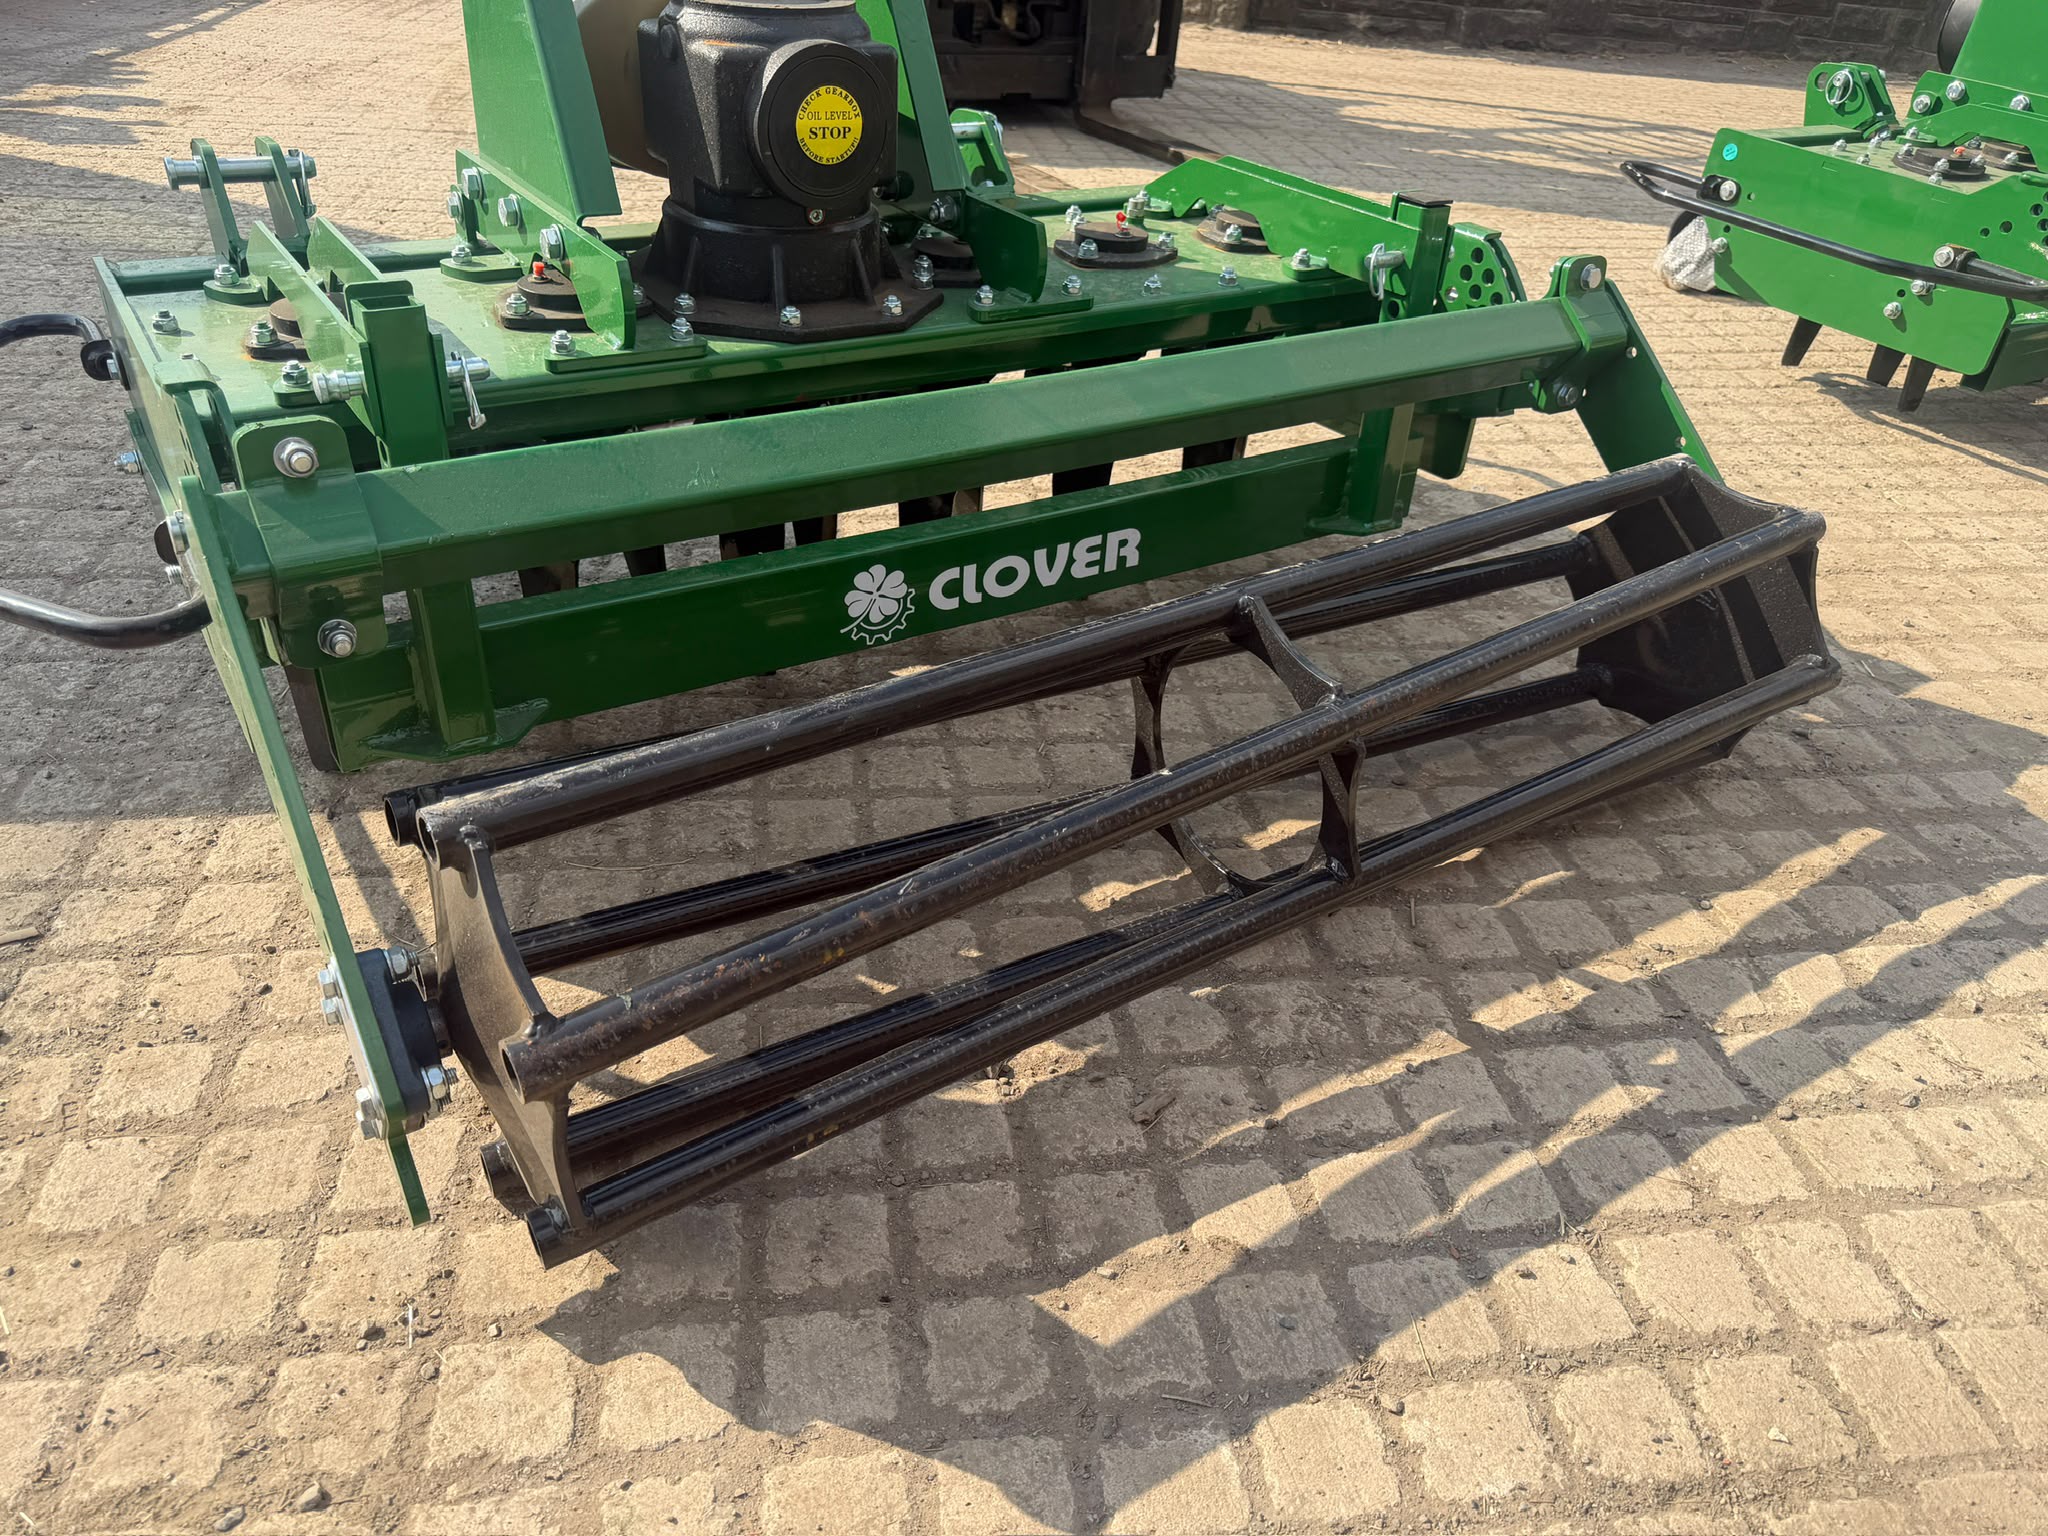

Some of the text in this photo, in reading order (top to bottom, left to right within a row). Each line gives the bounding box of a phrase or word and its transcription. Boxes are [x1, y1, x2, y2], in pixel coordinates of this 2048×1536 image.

[798, 87, 860, 120] CHECK GEARBOX
[807, 111, 853, 120] OIL LEVEL
[809, 126, 852, 140] STOP
[800, 137, 824, 163] BEFORE
[929, 528, 1142, 611] CLOVER
